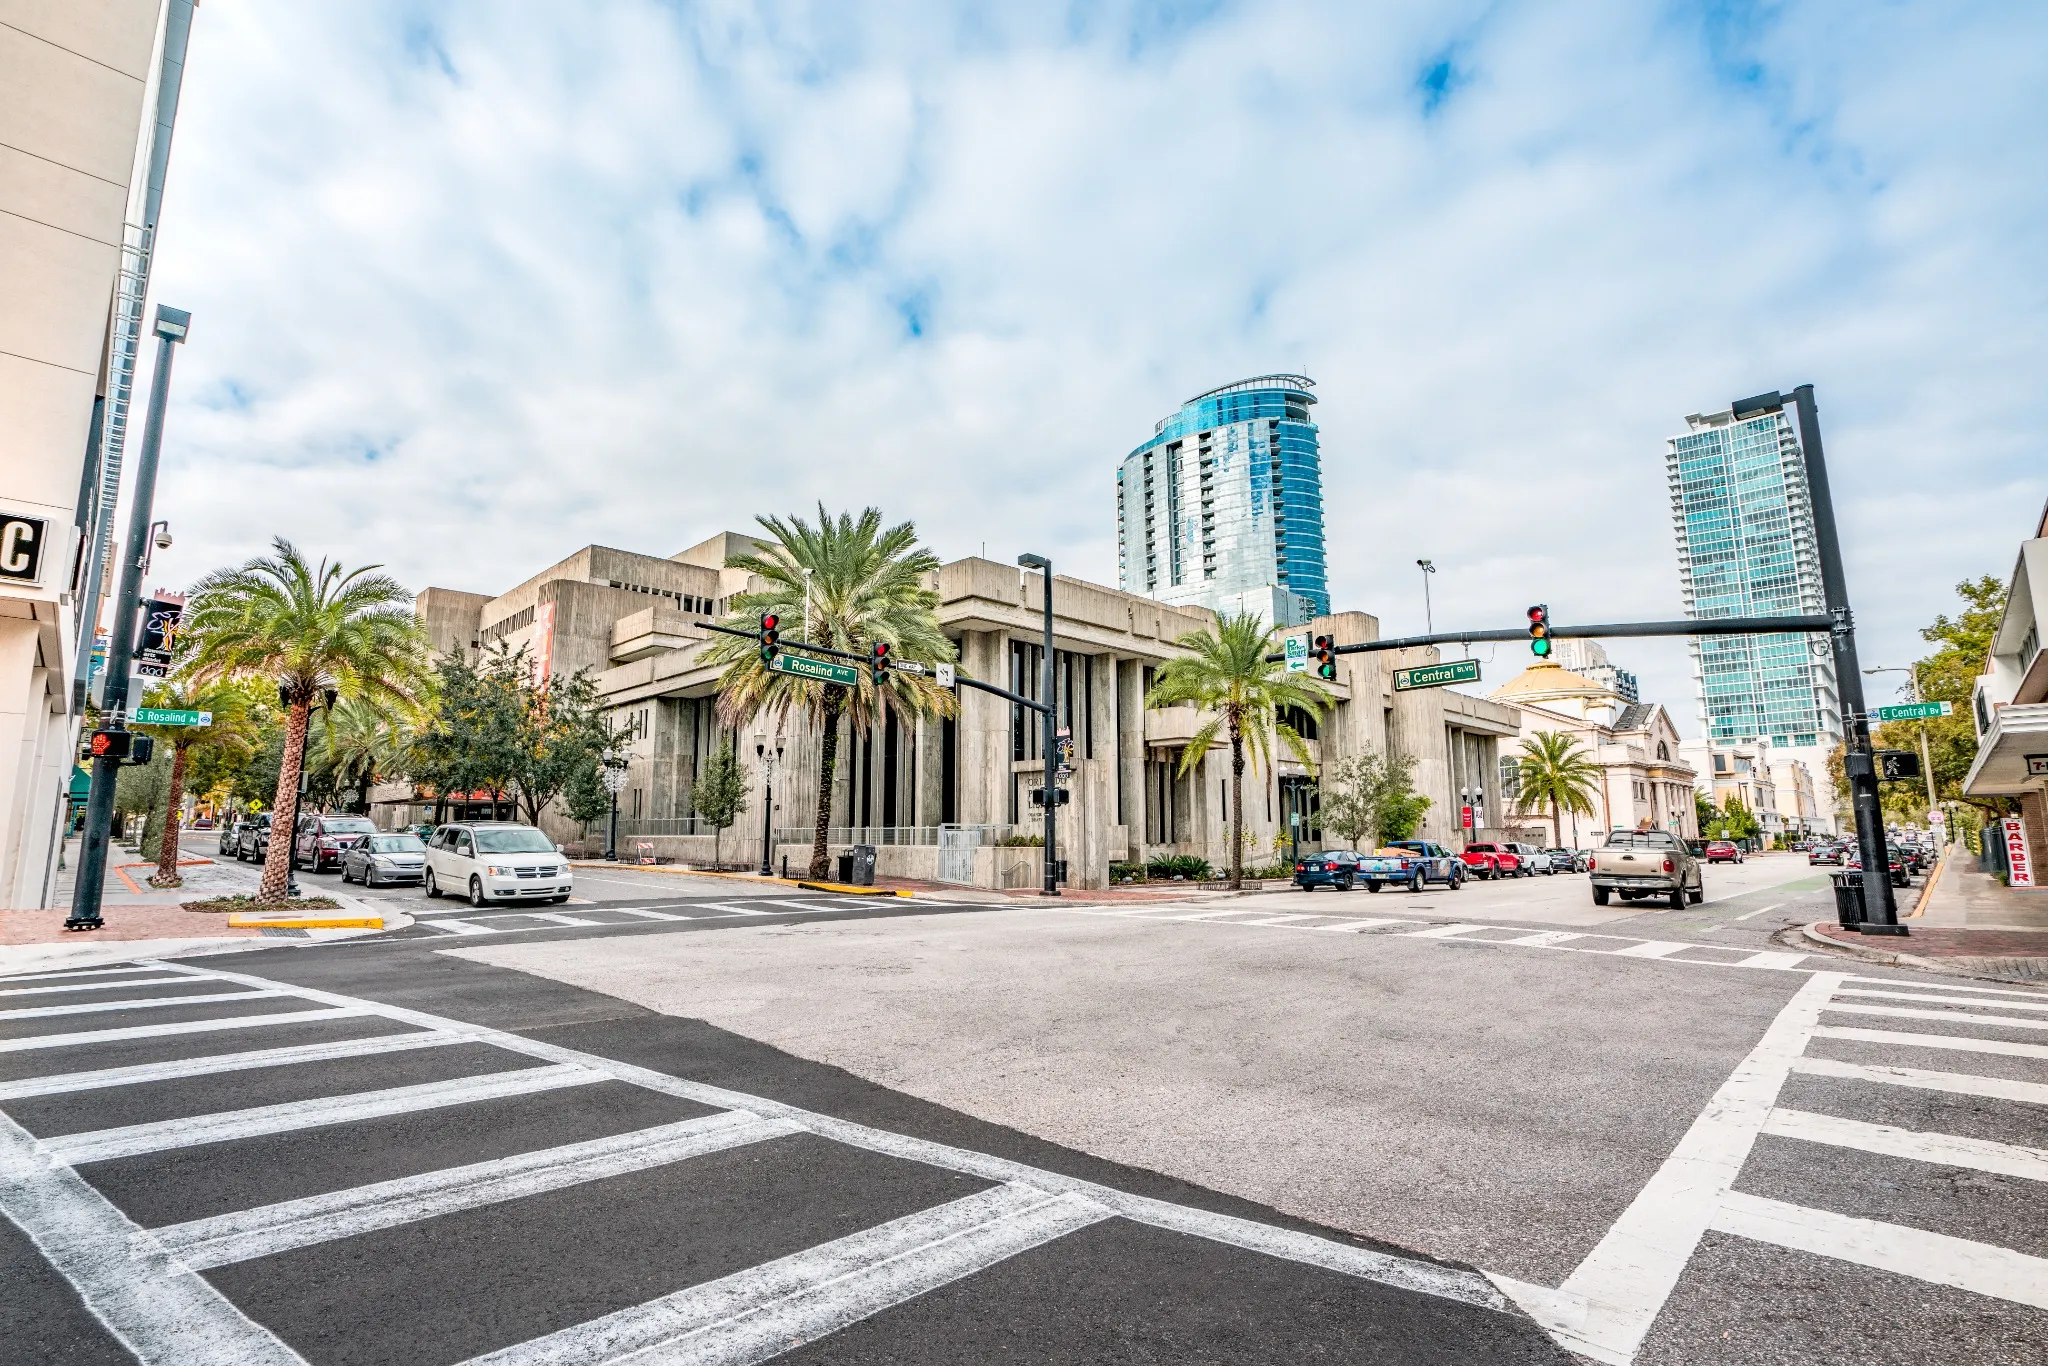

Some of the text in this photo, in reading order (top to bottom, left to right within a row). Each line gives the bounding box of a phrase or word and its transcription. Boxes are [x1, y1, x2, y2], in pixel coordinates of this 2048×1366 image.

[791, 659, 849, 677] Rosalind AVE
[1413, 665, 1474, 683] Central BLVD
[137, 711, 144, 720] S
[147, 711, 187, 723] Rosalind
[1881, 709, 1888, 719] E
[1891, 706, 1926, 718] Central
[1028, 778, 1066, 786] ORLDO
[2005, 822, 2030, 882] BARBER
